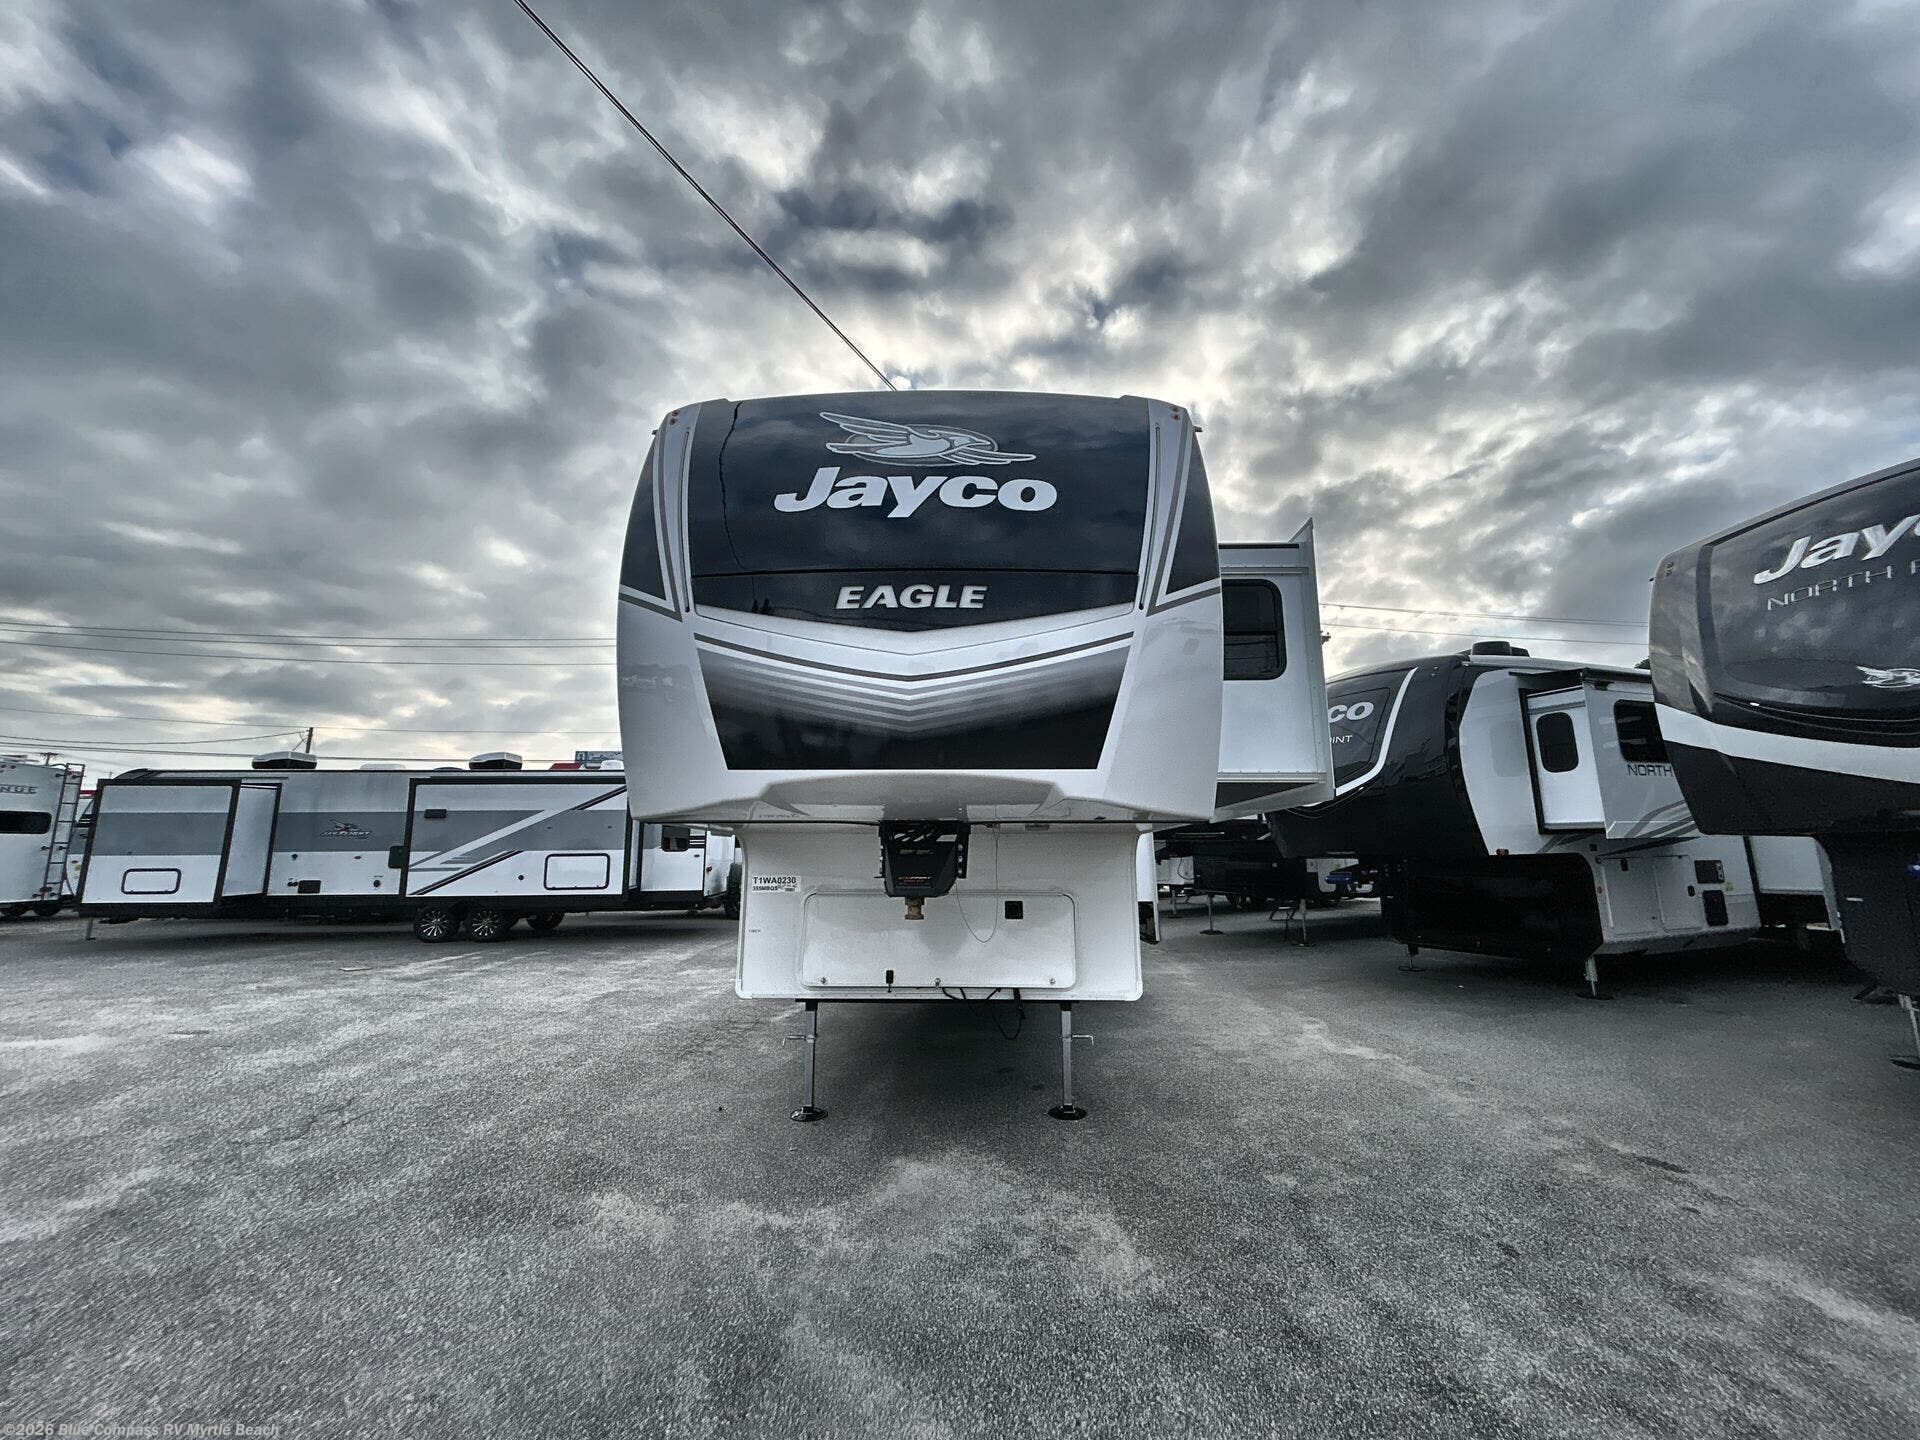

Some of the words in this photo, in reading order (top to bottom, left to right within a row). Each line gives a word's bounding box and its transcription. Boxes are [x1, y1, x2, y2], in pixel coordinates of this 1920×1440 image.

[773, 466, 1058, 518] Jayco
[835, 584, 988, 610] EAGLE
[1767, 565, 1893, 611] NORTH
[1627, 764, 1673, 776] NORTH
[753, 876, 797, 884] T1WA0230
